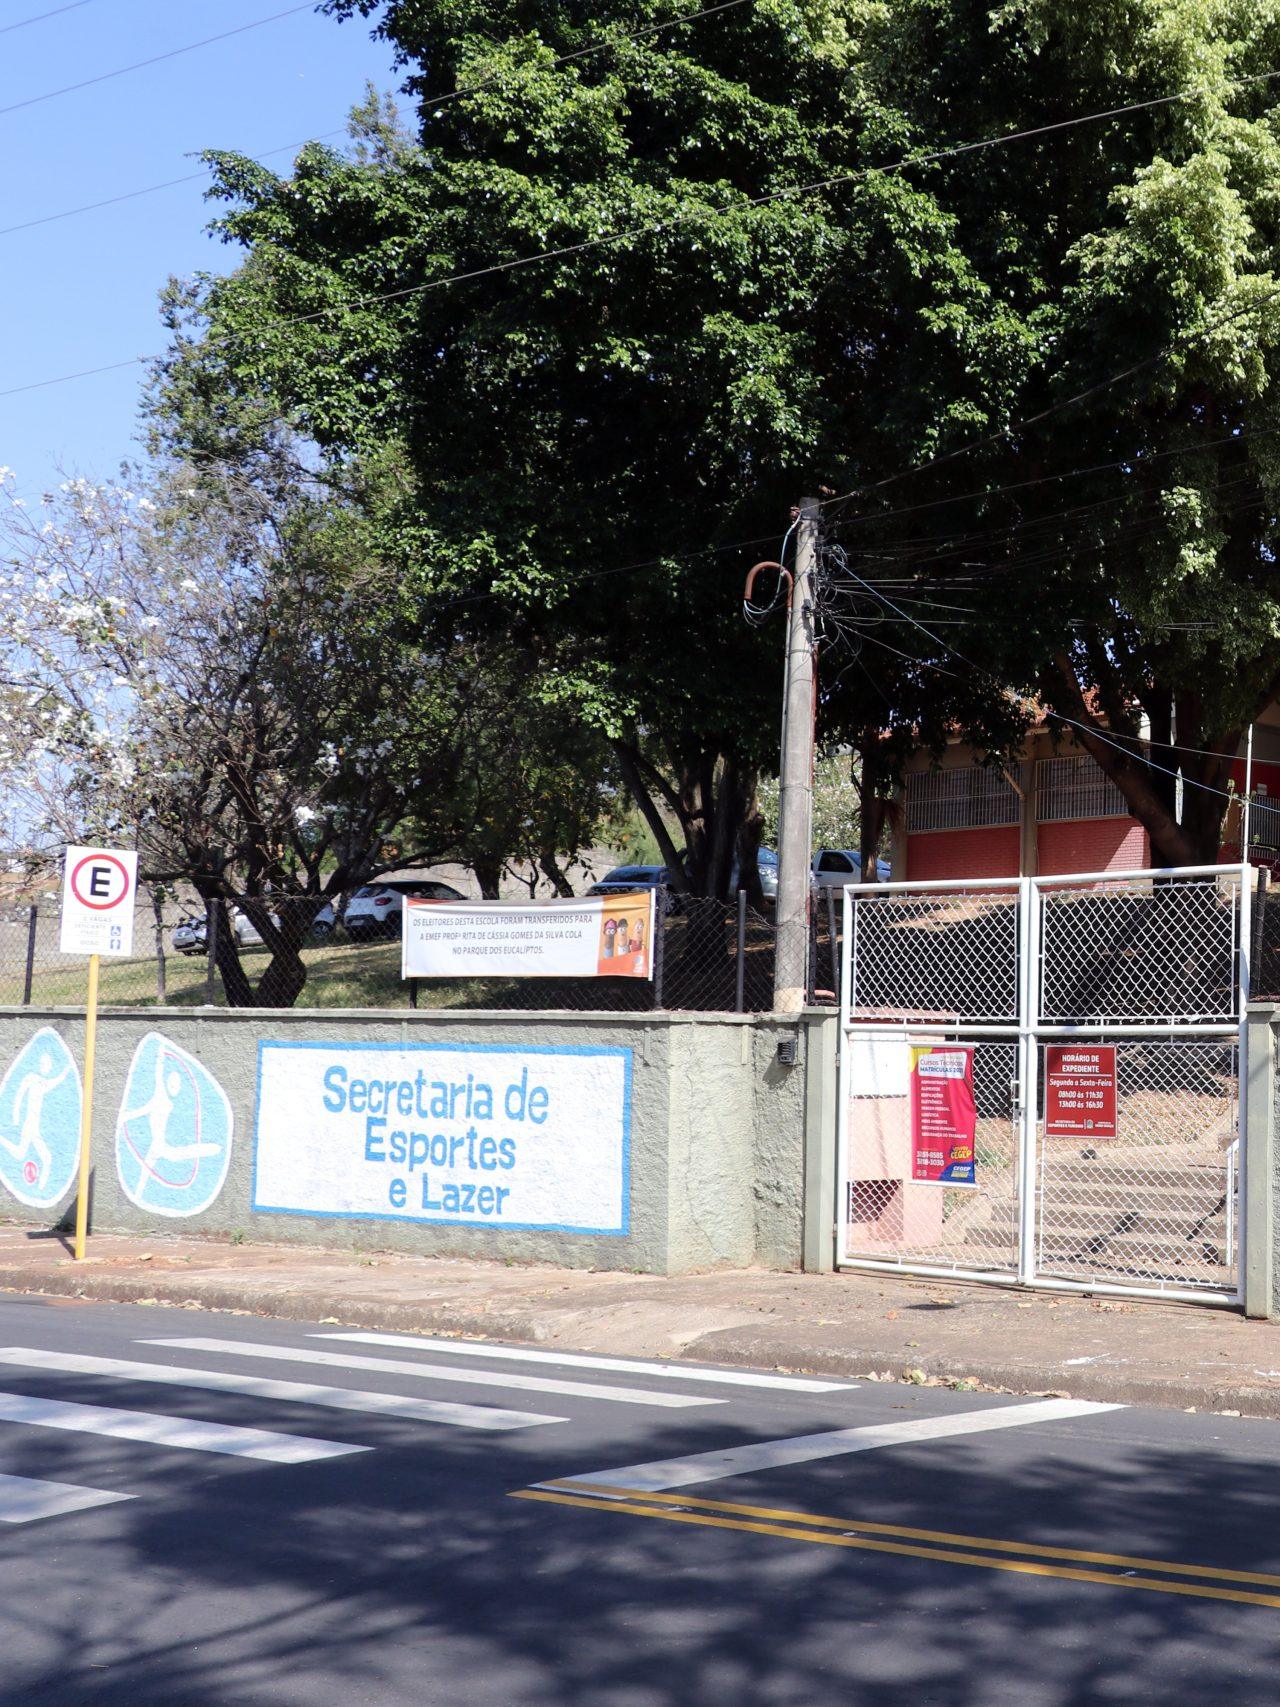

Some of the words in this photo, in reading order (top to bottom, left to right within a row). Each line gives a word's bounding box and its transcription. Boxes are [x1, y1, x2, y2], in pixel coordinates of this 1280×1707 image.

[90, 866, 111, 897] E
[413, 918, 421, 926] OS
[422, 918, 453, 926] ELEITORES
[455, 917, 474, 925] DESTA
[476, 917, 499, 925] ESCOLA
[501, 916, 523, 924] FORAM
[524, 915, 573, 924] TRANSFERIDOS
[575, 915, 592, 923] PARA
[463, 932, 476, 940] RITA
[487, 930, 509, 939] CÁSSIA
[510, 931, 533, 939] GOMES
[535, 931, 543, 939] DA
[545, 931, 564, 939] SILVA
[565, 930, 582, 938] COLA
[463, 947, 488, 955] PARQUE
[490, 946, 502, 954] DOS
[1062, 1053, 1089, 1063] HORÁRIO
[1091, 1055, 1100, 1063] DE
[1062, 1065, 1100, 1073] EXPEDIENTE
[1050, 1078, 1074, 1087] Segunda
[322, 1065, 494, 1120] Secretaria
[504, 1066, 550, 1125] de
[1086, 1091, 1104, 1099] 11h30
[364, 1116, 516, 1172] Esportes
[389, 1177, 407, 1209] e
[421, 1172, 511, 1216] Lazer
